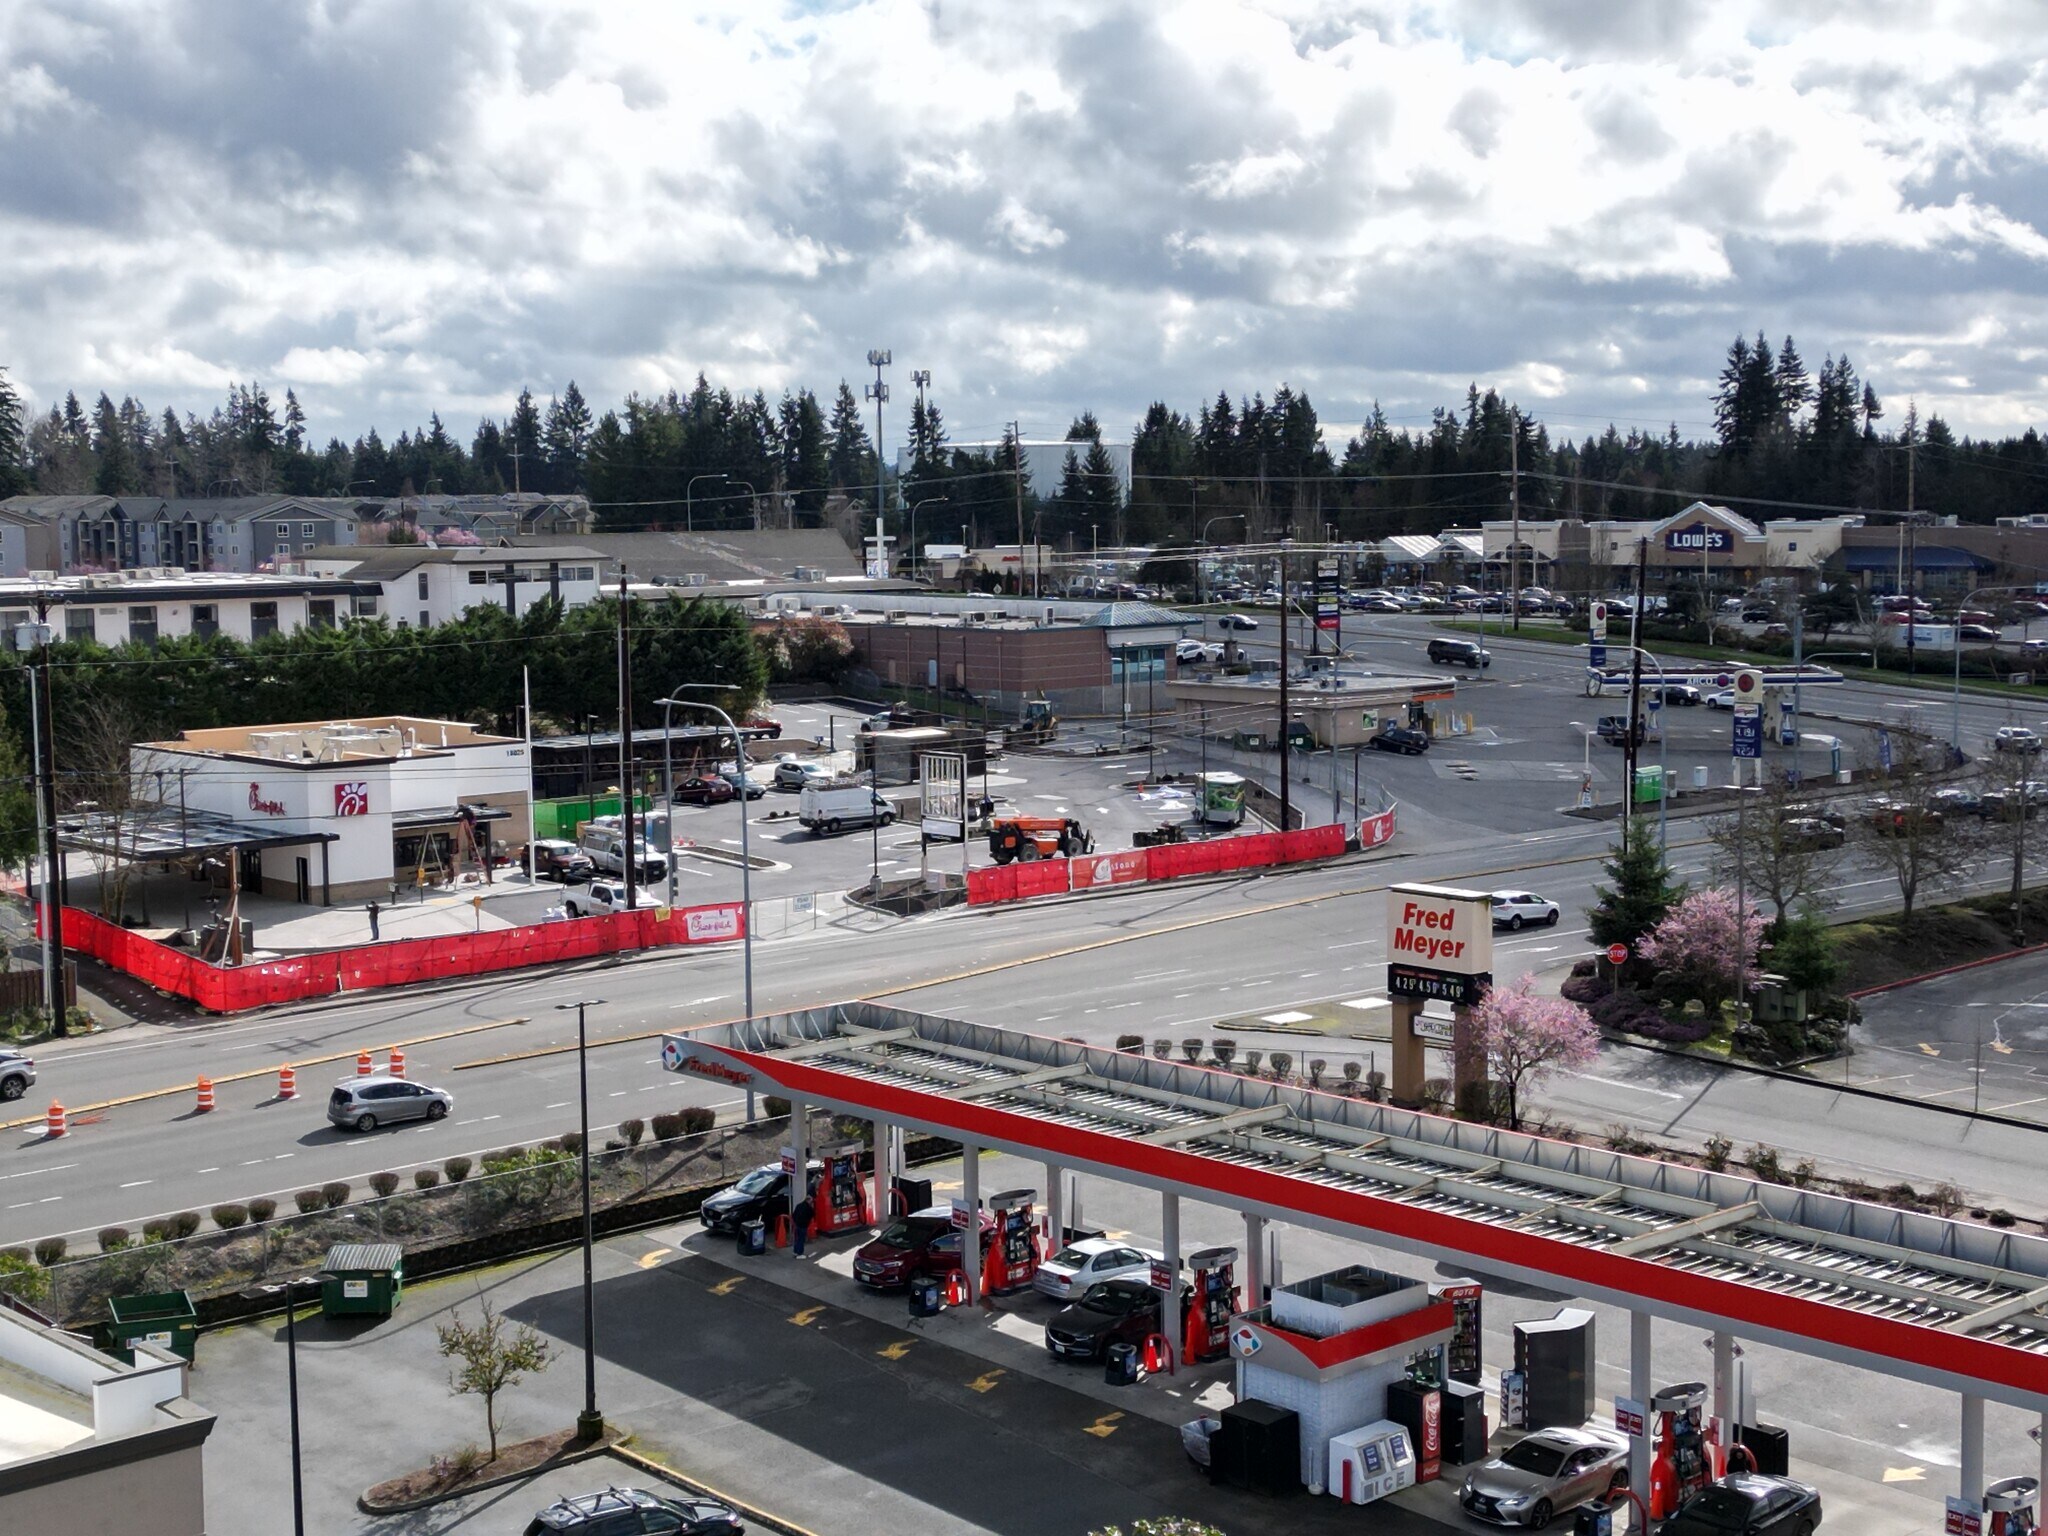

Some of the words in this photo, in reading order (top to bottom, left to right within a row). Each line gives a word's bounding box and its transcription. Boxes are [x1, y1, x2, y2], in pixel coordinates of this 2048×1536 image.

[1673, 532, 1723, 547] LOWE'S
[1687, 677, 1713, 685] ARCO
[1403, 902, 1455, 931] Fred
[1394, 927, 1465, 960] Meyer
[1374, 1471, 1406, 1496] ICE
